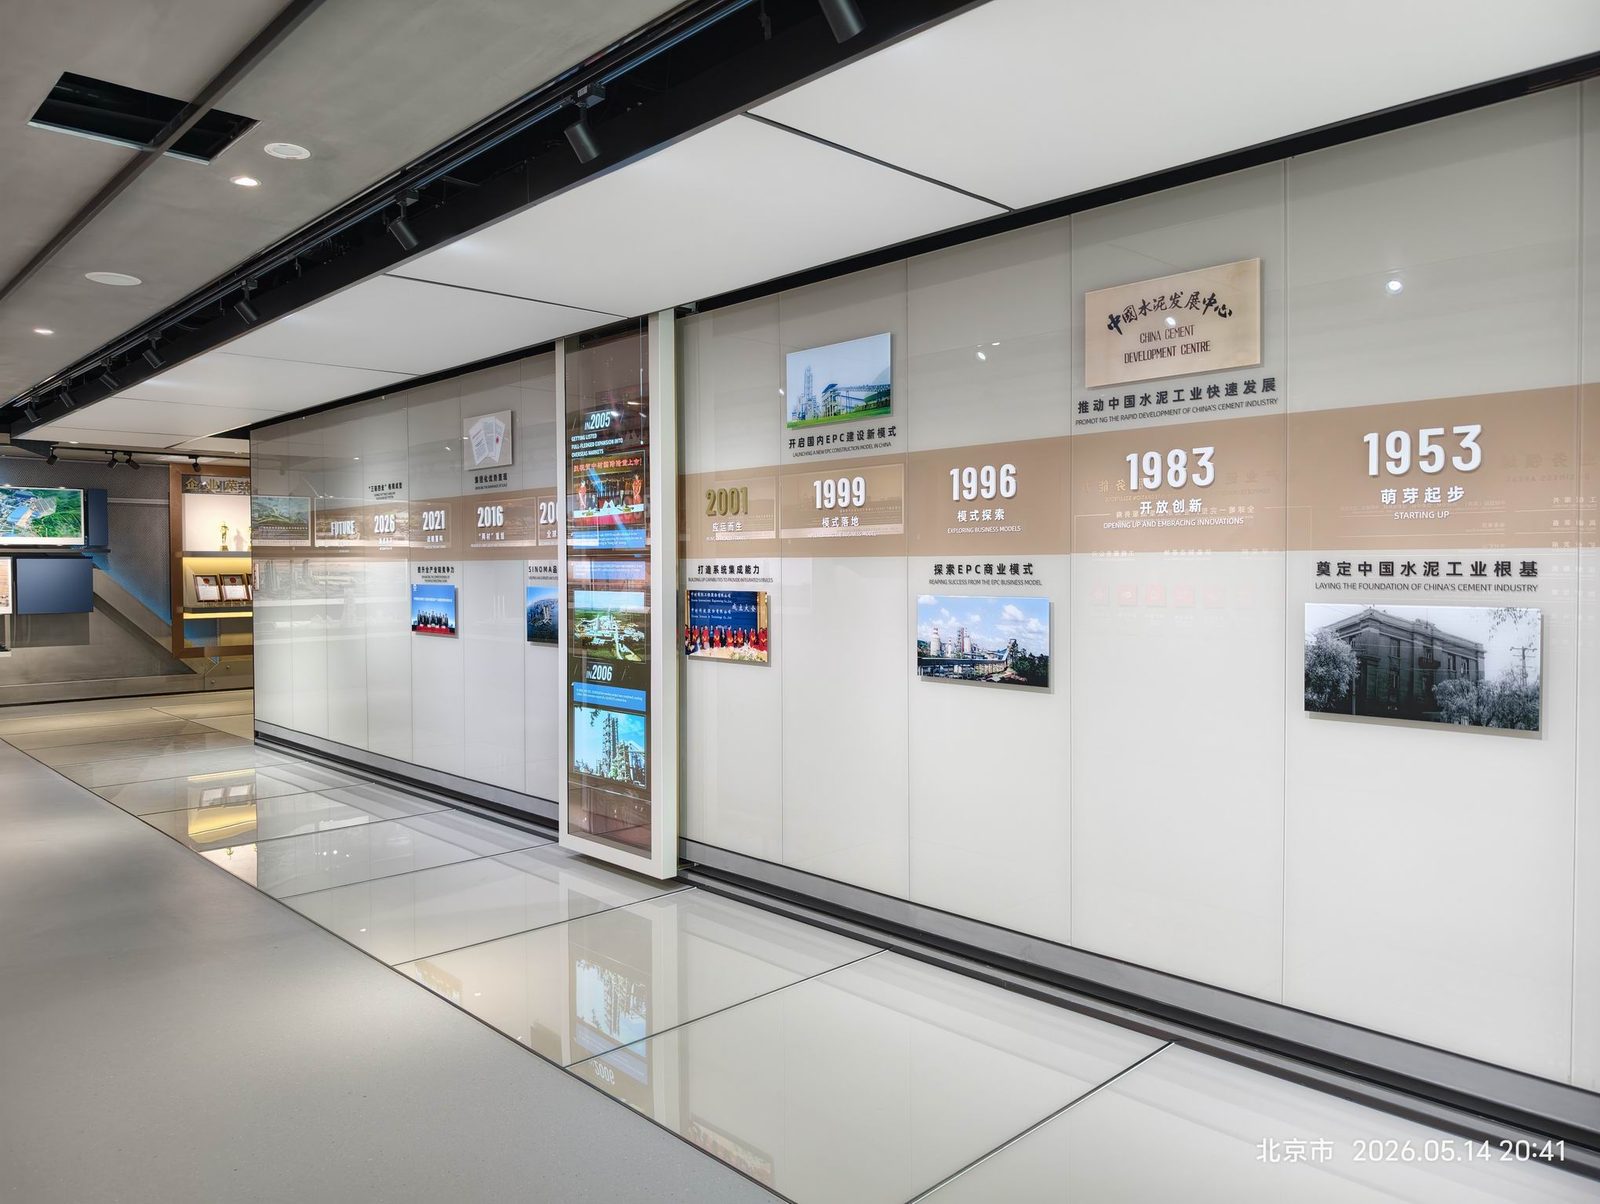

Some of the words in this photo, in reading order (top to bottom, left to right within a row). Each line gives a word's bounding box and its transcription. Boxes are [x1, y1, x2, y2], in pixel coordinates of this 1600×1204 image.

[1139, 330, 1162, 344] CHINA
[1164, 324, 1195, 340] CEMENT
[1124, 346, 1177, 364] DEVELOPMENT
[1180, 340, 1212, 356] CENTRE
[1077, 377, 1277, 414] 推动中国水泥工业快速发展
[1108, 414, 1120, 423] THE
[1120, 412, 1138, 421] RAPID
[1138, 408, 1181, 420] DEVELOPMENT
[1182, 406, 1192, 414] OF
[1191, 403, 1218, 413] CHINA'S
[1217, 401, 1244, 411] CEMENT
[1245, 397, 1279, 408] INDUSTRY
[590, 411, 611, 430] 2005
[788, 426, 897, 449] 开启国内EPC建设新模式
[1363, 424, 1482, 477] 1953
[1125, 446, 1216, 491] 1983
[949, 463, 1017, 501] 1996
[705, 486, 749, 518] 2001
[813, 476, 866, 509] 1999
[1380, 485, 1465, 505] 萌芽起步
[957, 508, 1005, 522] 模式探索
[1139, 498, 1202, 515] 开放创新
[1394, 511, 1435, 520] STARTING
[1437, 510, 1450, 519] UP
[373, 514, 396, 533] 2026
[422, 510, 446, 531] 2021
[477, 505, 504, 528] 2016
[822, 515, 860, 528] 模式落地
[1103, 521, 1131, 529] OPENING
[1142, 520, 1157, 528] AND
[1157, 518, 1196, 528] EMBRACING
[1196, 517, 1244, 526] INNOVATIONS
[330, 520, 356, 536] FUTURE
[999, 525, 1021, 533] MODELS
[697, 564, 760, 575] 打造系统集成能力
[933, 563, 1034, 576] 探索EPC商业模式
[1316, 560, 1538, 578] 奠定中国水泥工业根基
[1315, 582, 1342, 591] LAYING
[1343, 582, 1357, 591] THE
[1358, 582, 1410, 591] FOUNDATION
[1410, 583, 1422, 591] OF
[1423, 583, 1456, 592] CHINA'S
[1457, 583, 1492, 592] CEMENT
[1494, 584, 1538, 593] INDUSTRY
[591, 664, 613, 682] 2006
